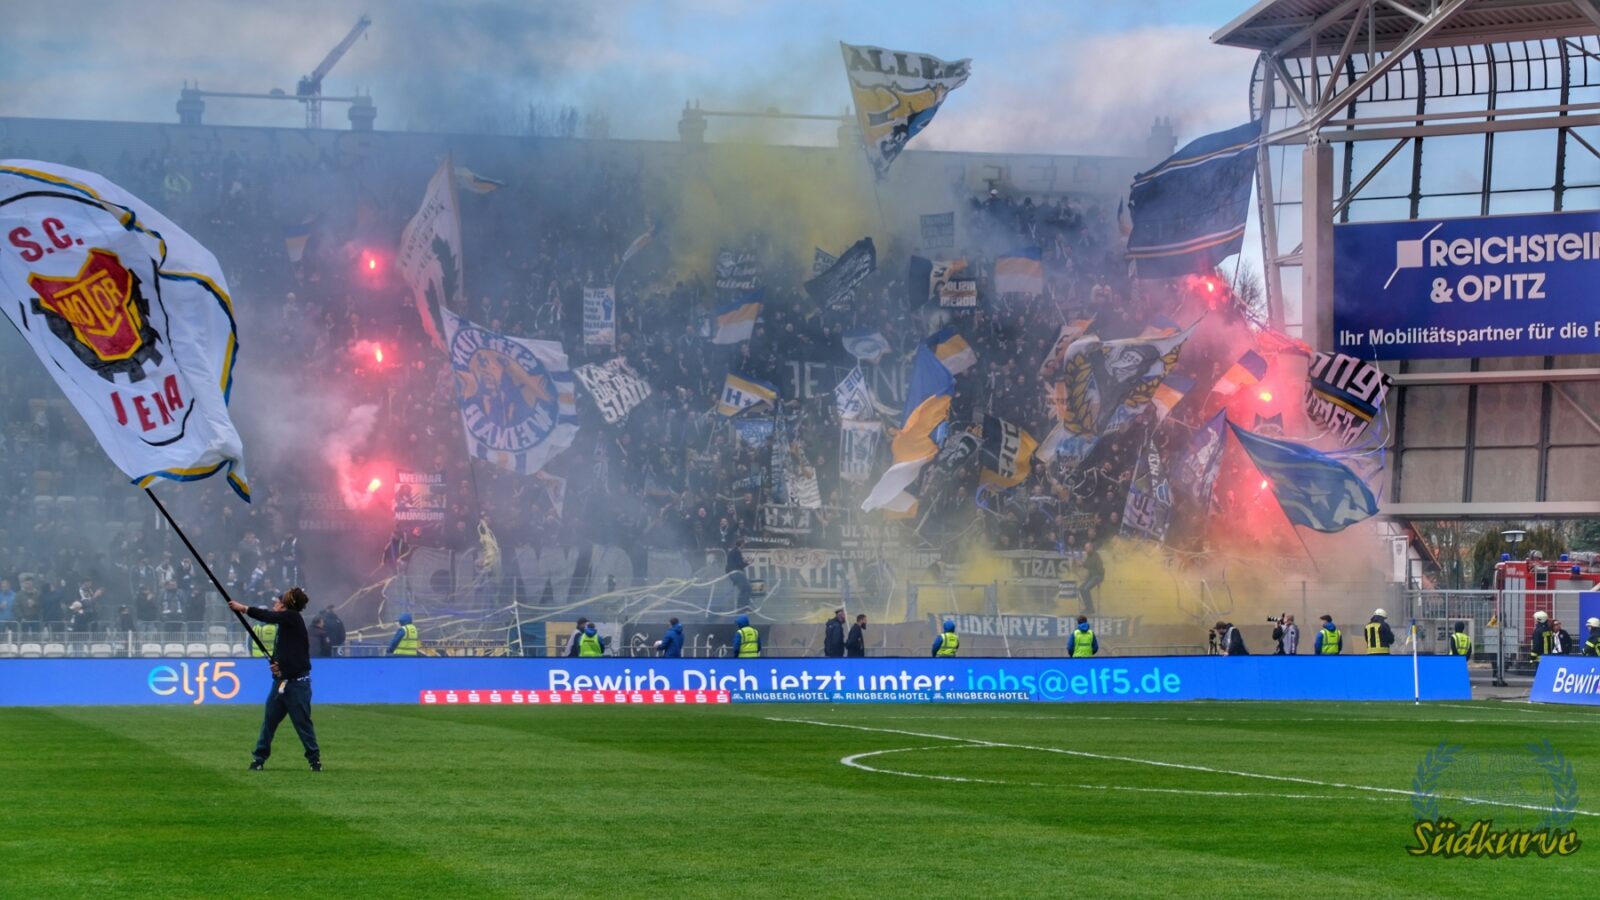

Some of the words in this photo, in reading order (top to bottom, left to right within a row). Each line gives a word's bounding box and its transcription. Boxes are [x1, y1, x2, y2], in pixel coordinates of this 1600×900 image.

[54, 268, 123, 334] MOTOR
[1430, 277, 1453, 304] &
[1457, 272, 1546, 303] OPITZ
[1340, 330, 1363, 346] Ihr
[1369, 326, 1523, 346] Mobilitätspartner
[1528, 323, 1555, 340] für
[1560, 322, 1588, 339] die
[147, 661, 241, 705] elf5
[549, 669, 670, 692] Bewirb
[682, 669, 759, 692] Dich
[769, 668, 846, 692] jetzt
[858, 669, 955, 692] unter:
[966, 667, 1182, 701] jobs@elf5.de
[745, 692, 796, 700] RINGBERG
[797, 692, 830, 700] HOTEL
[845, 692, 897, 700] RINGBERG
[898, 692, 930, 700] HOTEL
[946, 691, 997, 700] RINGBERG
[998, 691, 1030, 700] HOTEL
